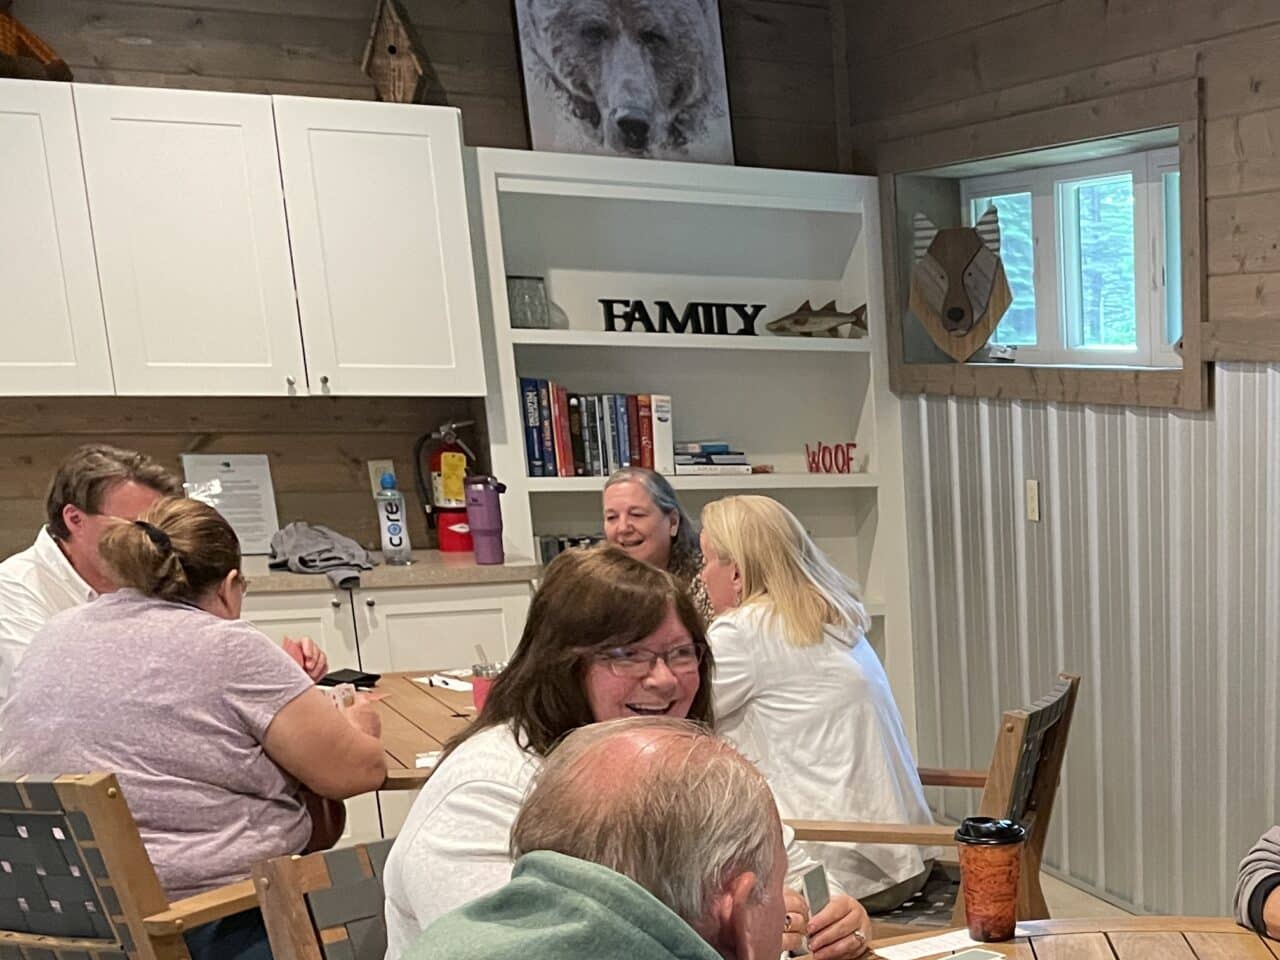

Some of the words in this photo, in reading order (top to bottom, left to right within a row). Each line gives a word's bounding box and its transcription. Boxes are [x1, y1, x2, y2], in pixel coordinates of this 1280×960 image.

[598, 299, 767, 336] FAMILY
[805, 441, 856, 474] WOOF
[385, 502, 402, 547] core
